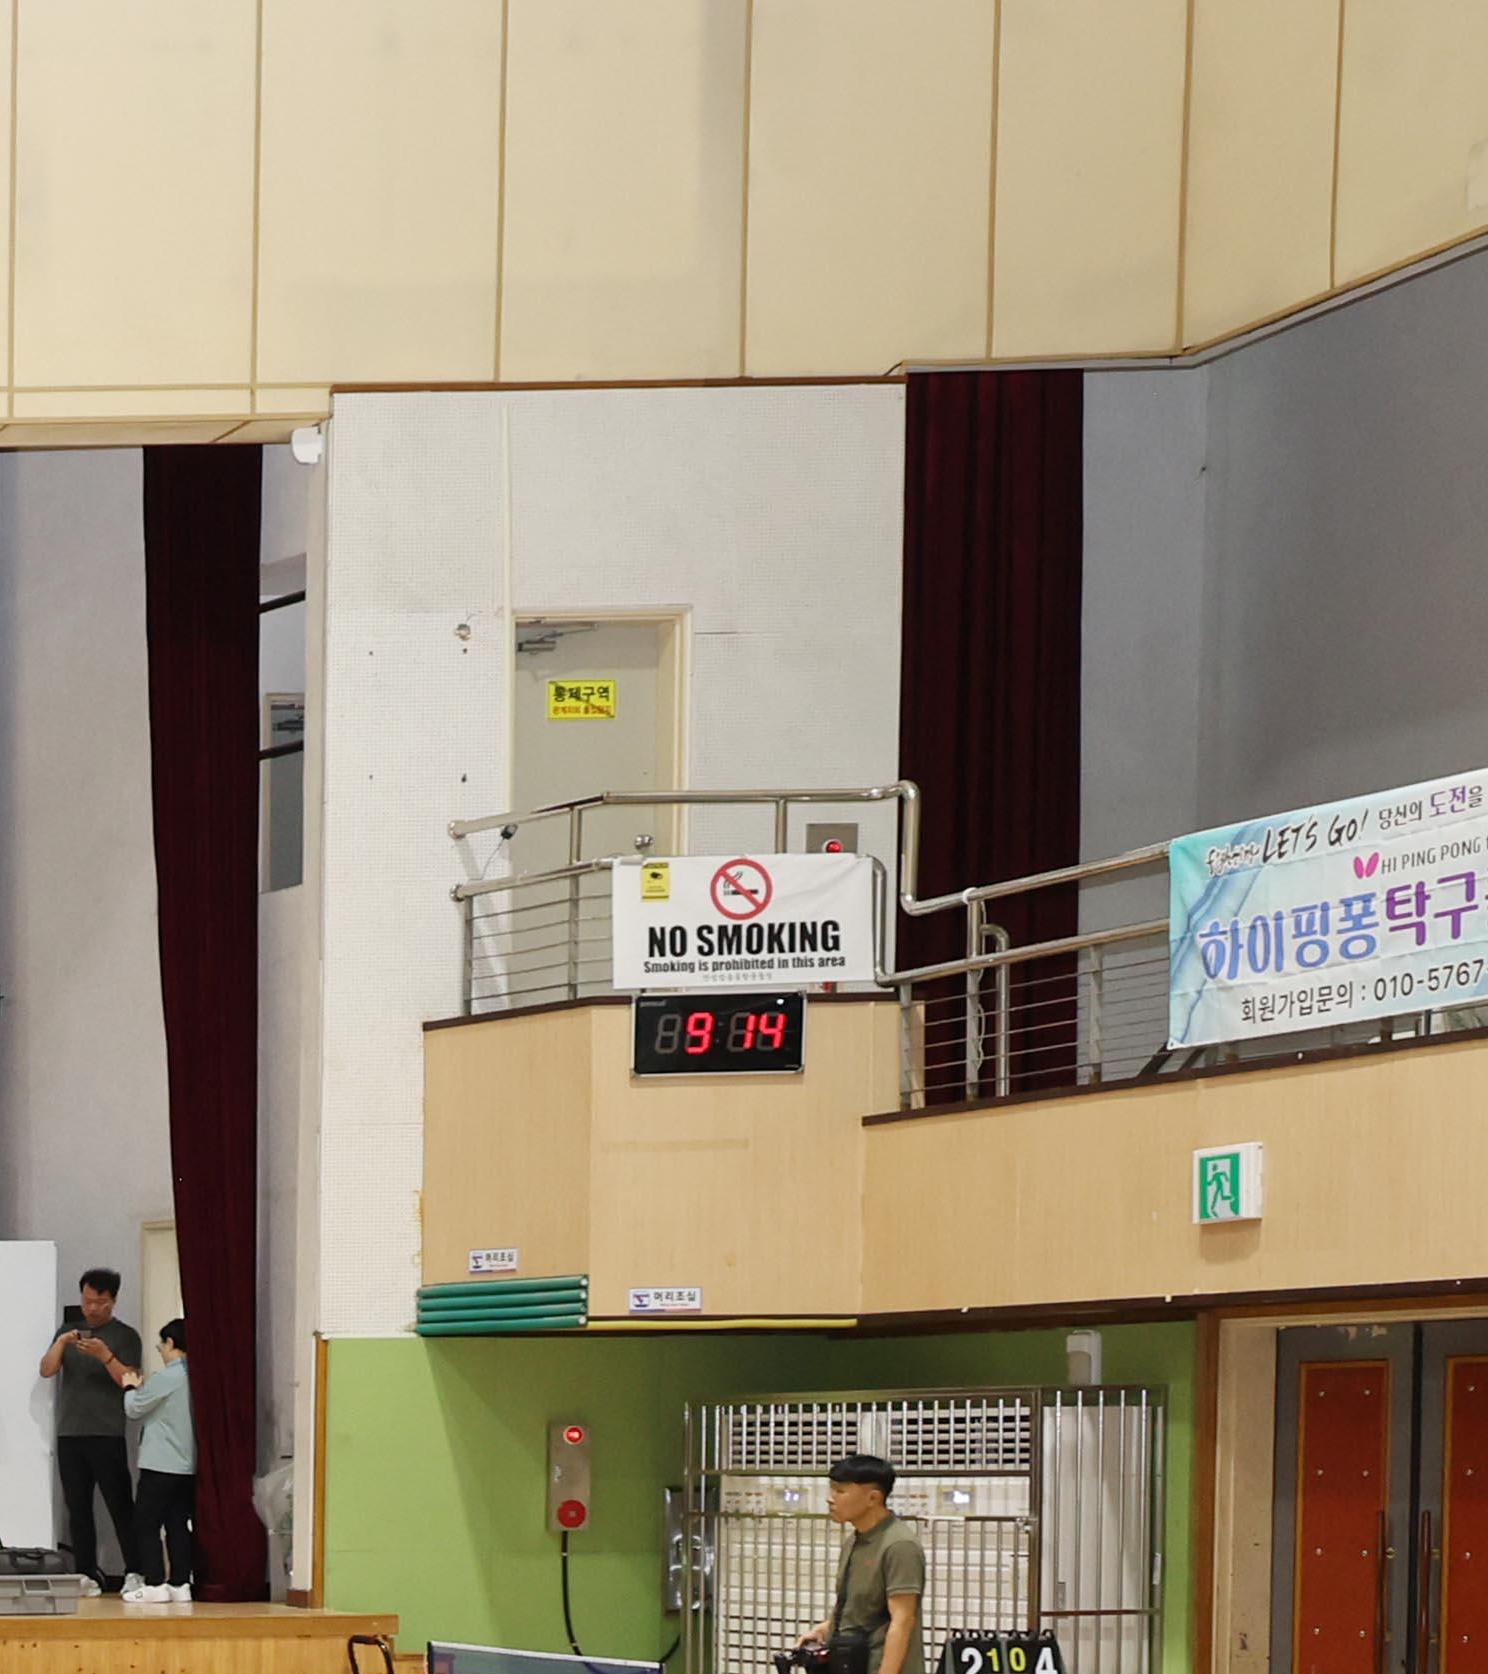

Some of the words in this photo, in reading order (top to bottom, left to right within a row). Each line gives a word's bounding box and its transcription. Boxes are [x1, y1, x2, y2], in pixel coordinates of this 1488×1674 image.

[1328, 809, 1369, 847] GO!
[1379, 801, 1423, 829] 당신의
[1430, 785, 1483, 817] 도전을
[1381, 857, 1398, 875] HI
[1402, 846, 1436, 870] PING
[1440, 838, 1482, 862] PONG
[648, 925, 688, 957] NO
[696, 919, 841, 957] SMOKING
[1197, 871, 1488, 980] 하이핑퐁탁구
[644, 960, 696, 973] Smoking
[698, 959, 709, 972] is
[712, 957, 775, 974] prohibited
[777, 956, 789, 969] in
[792, 955, 815, 968] this
[817, 955, 846, 968] area
[1241, 980, 1355, 1024] 회원가입문의
[685, 1012, 715, 1055] 9
[743, 1013, 788, 1051] 14
[653, 1291, 696, 1302] 머리조심
[987, 1649, 999, 1672] 1
[1009, 1648, 1026, 1672] 0
